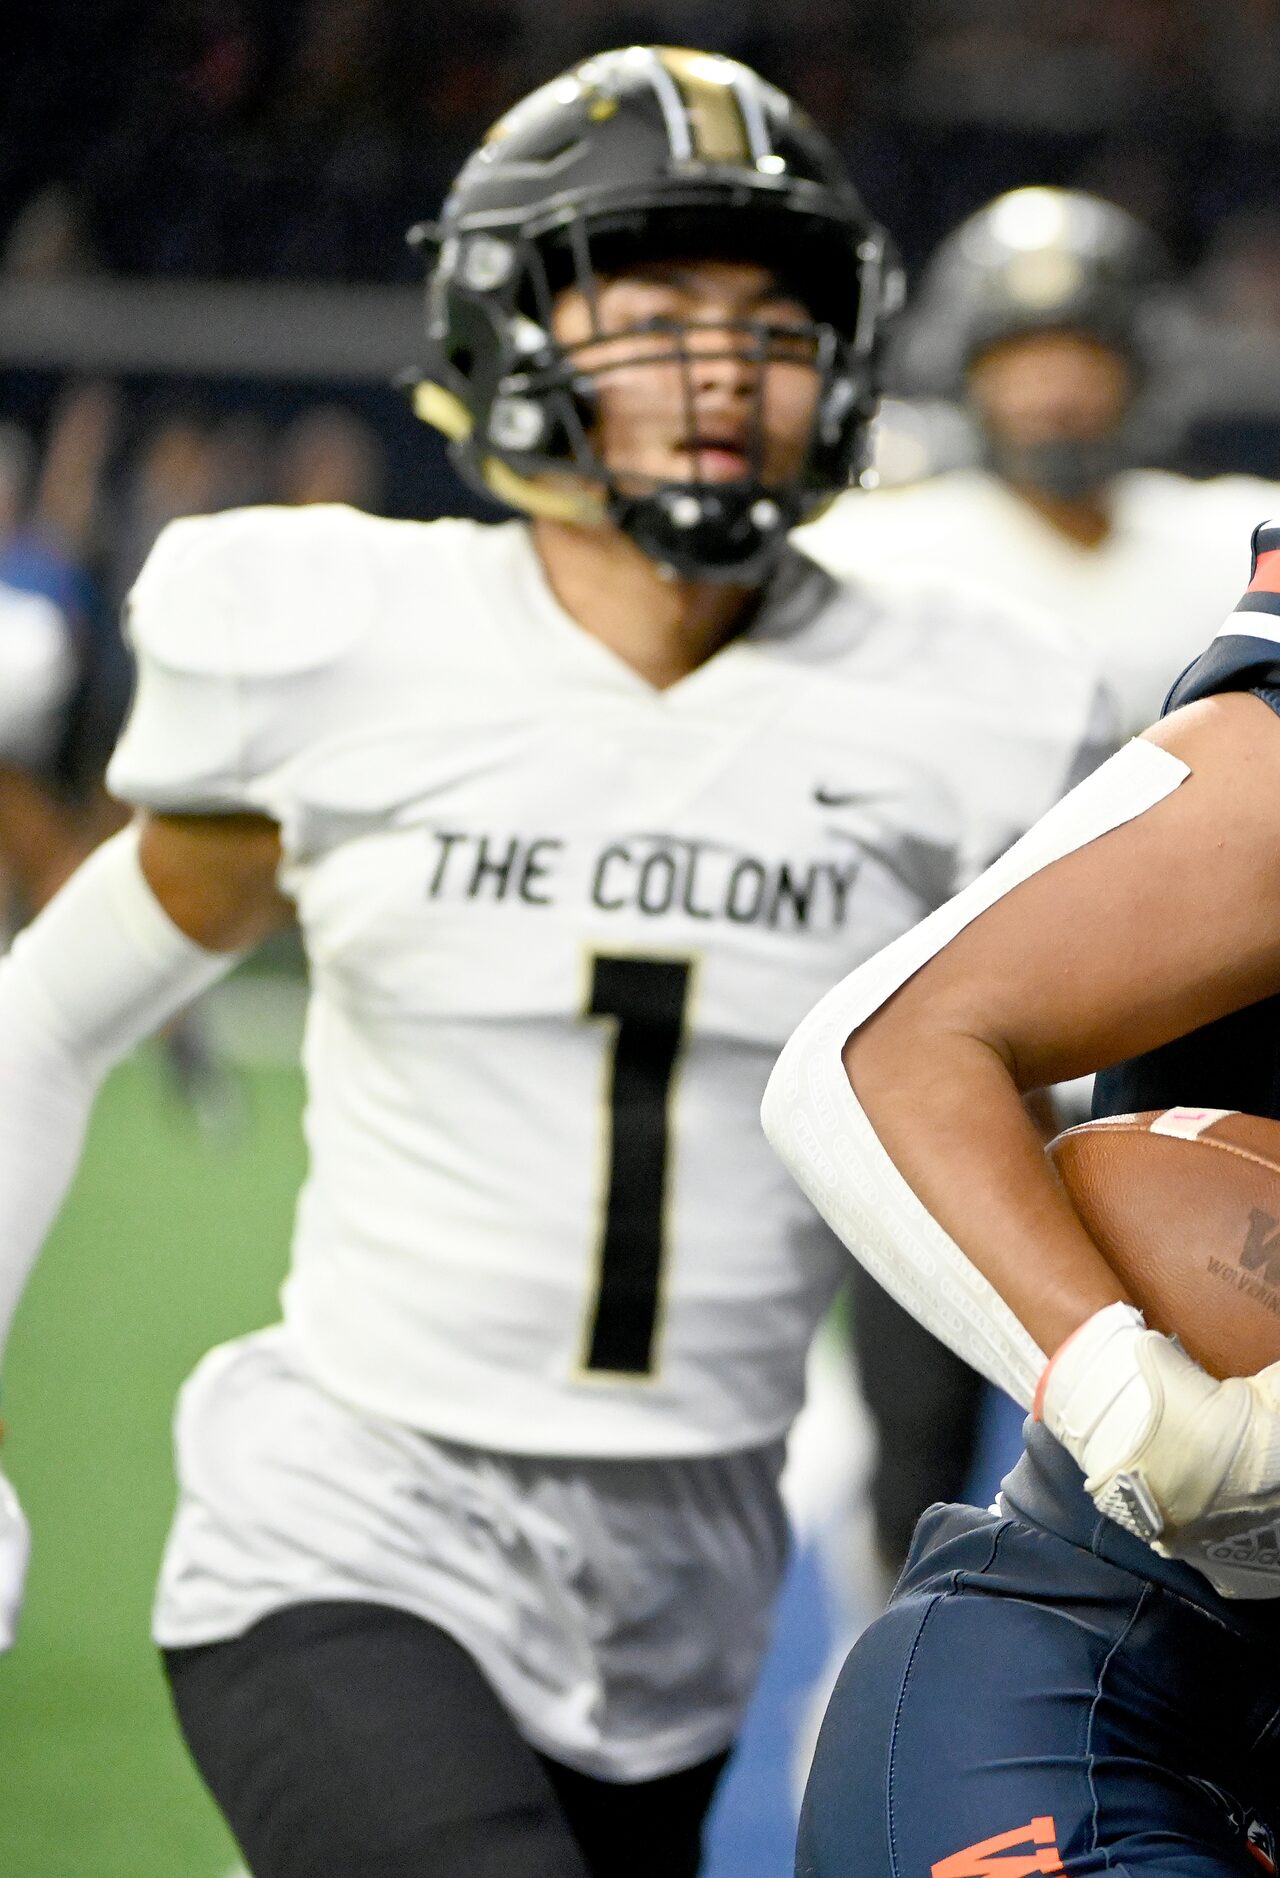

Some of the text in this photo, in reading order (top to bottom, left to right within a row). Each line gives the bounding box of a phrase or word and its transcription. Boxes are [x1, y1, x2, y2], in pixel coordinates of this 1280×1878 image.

[429, 832, 860, 930] THE COLONY
[572, 944, 700, 1382] 1
